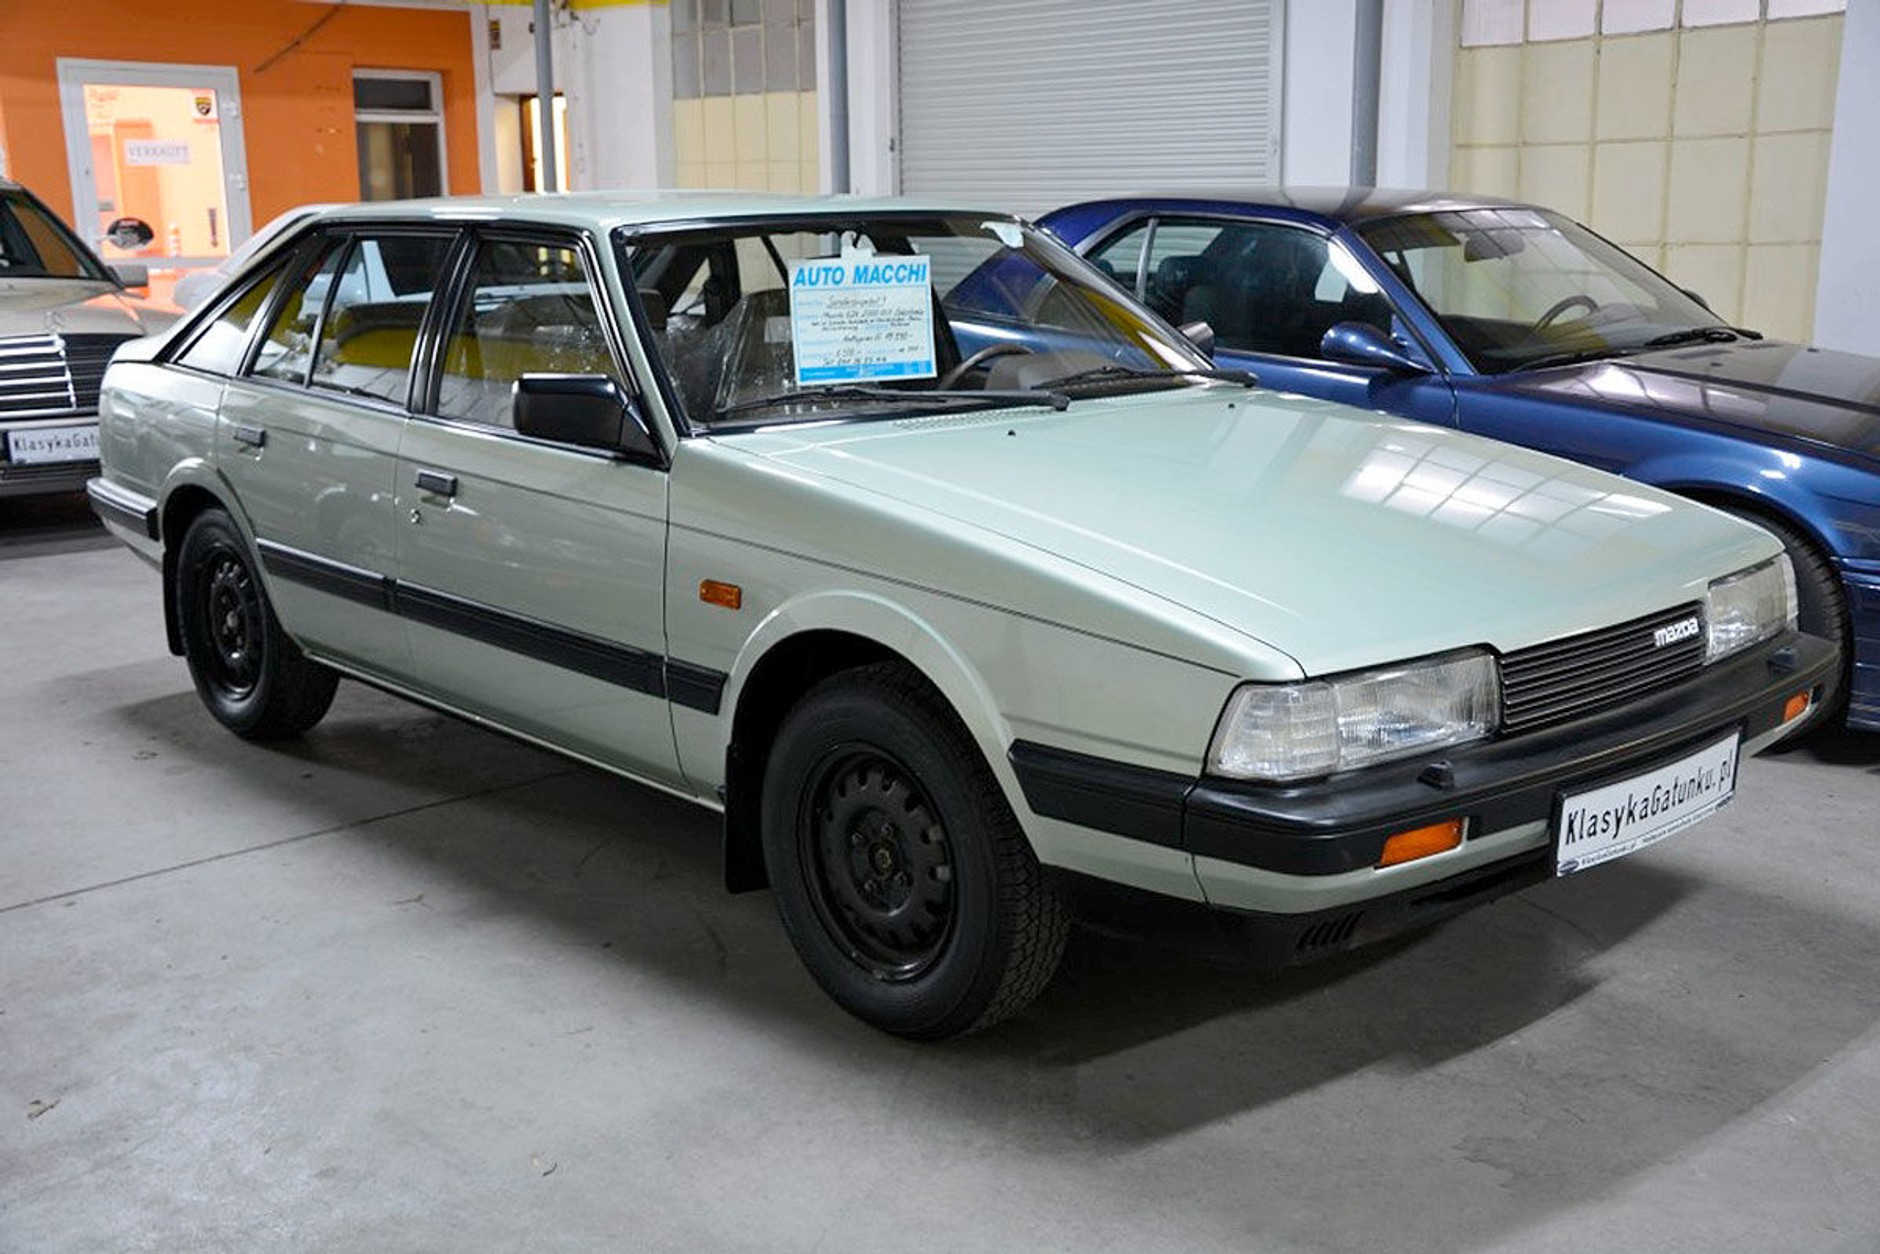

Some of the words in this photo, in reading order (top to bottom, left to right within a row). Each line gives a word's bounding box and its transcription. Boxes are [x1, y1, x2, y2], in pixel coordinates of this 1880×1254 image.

[794, 266, 844, 286] AUTO
[853, 264, 926, 284] MACCHI
[1565, 749, 1733, 845] KlasykaGatunku.pl
